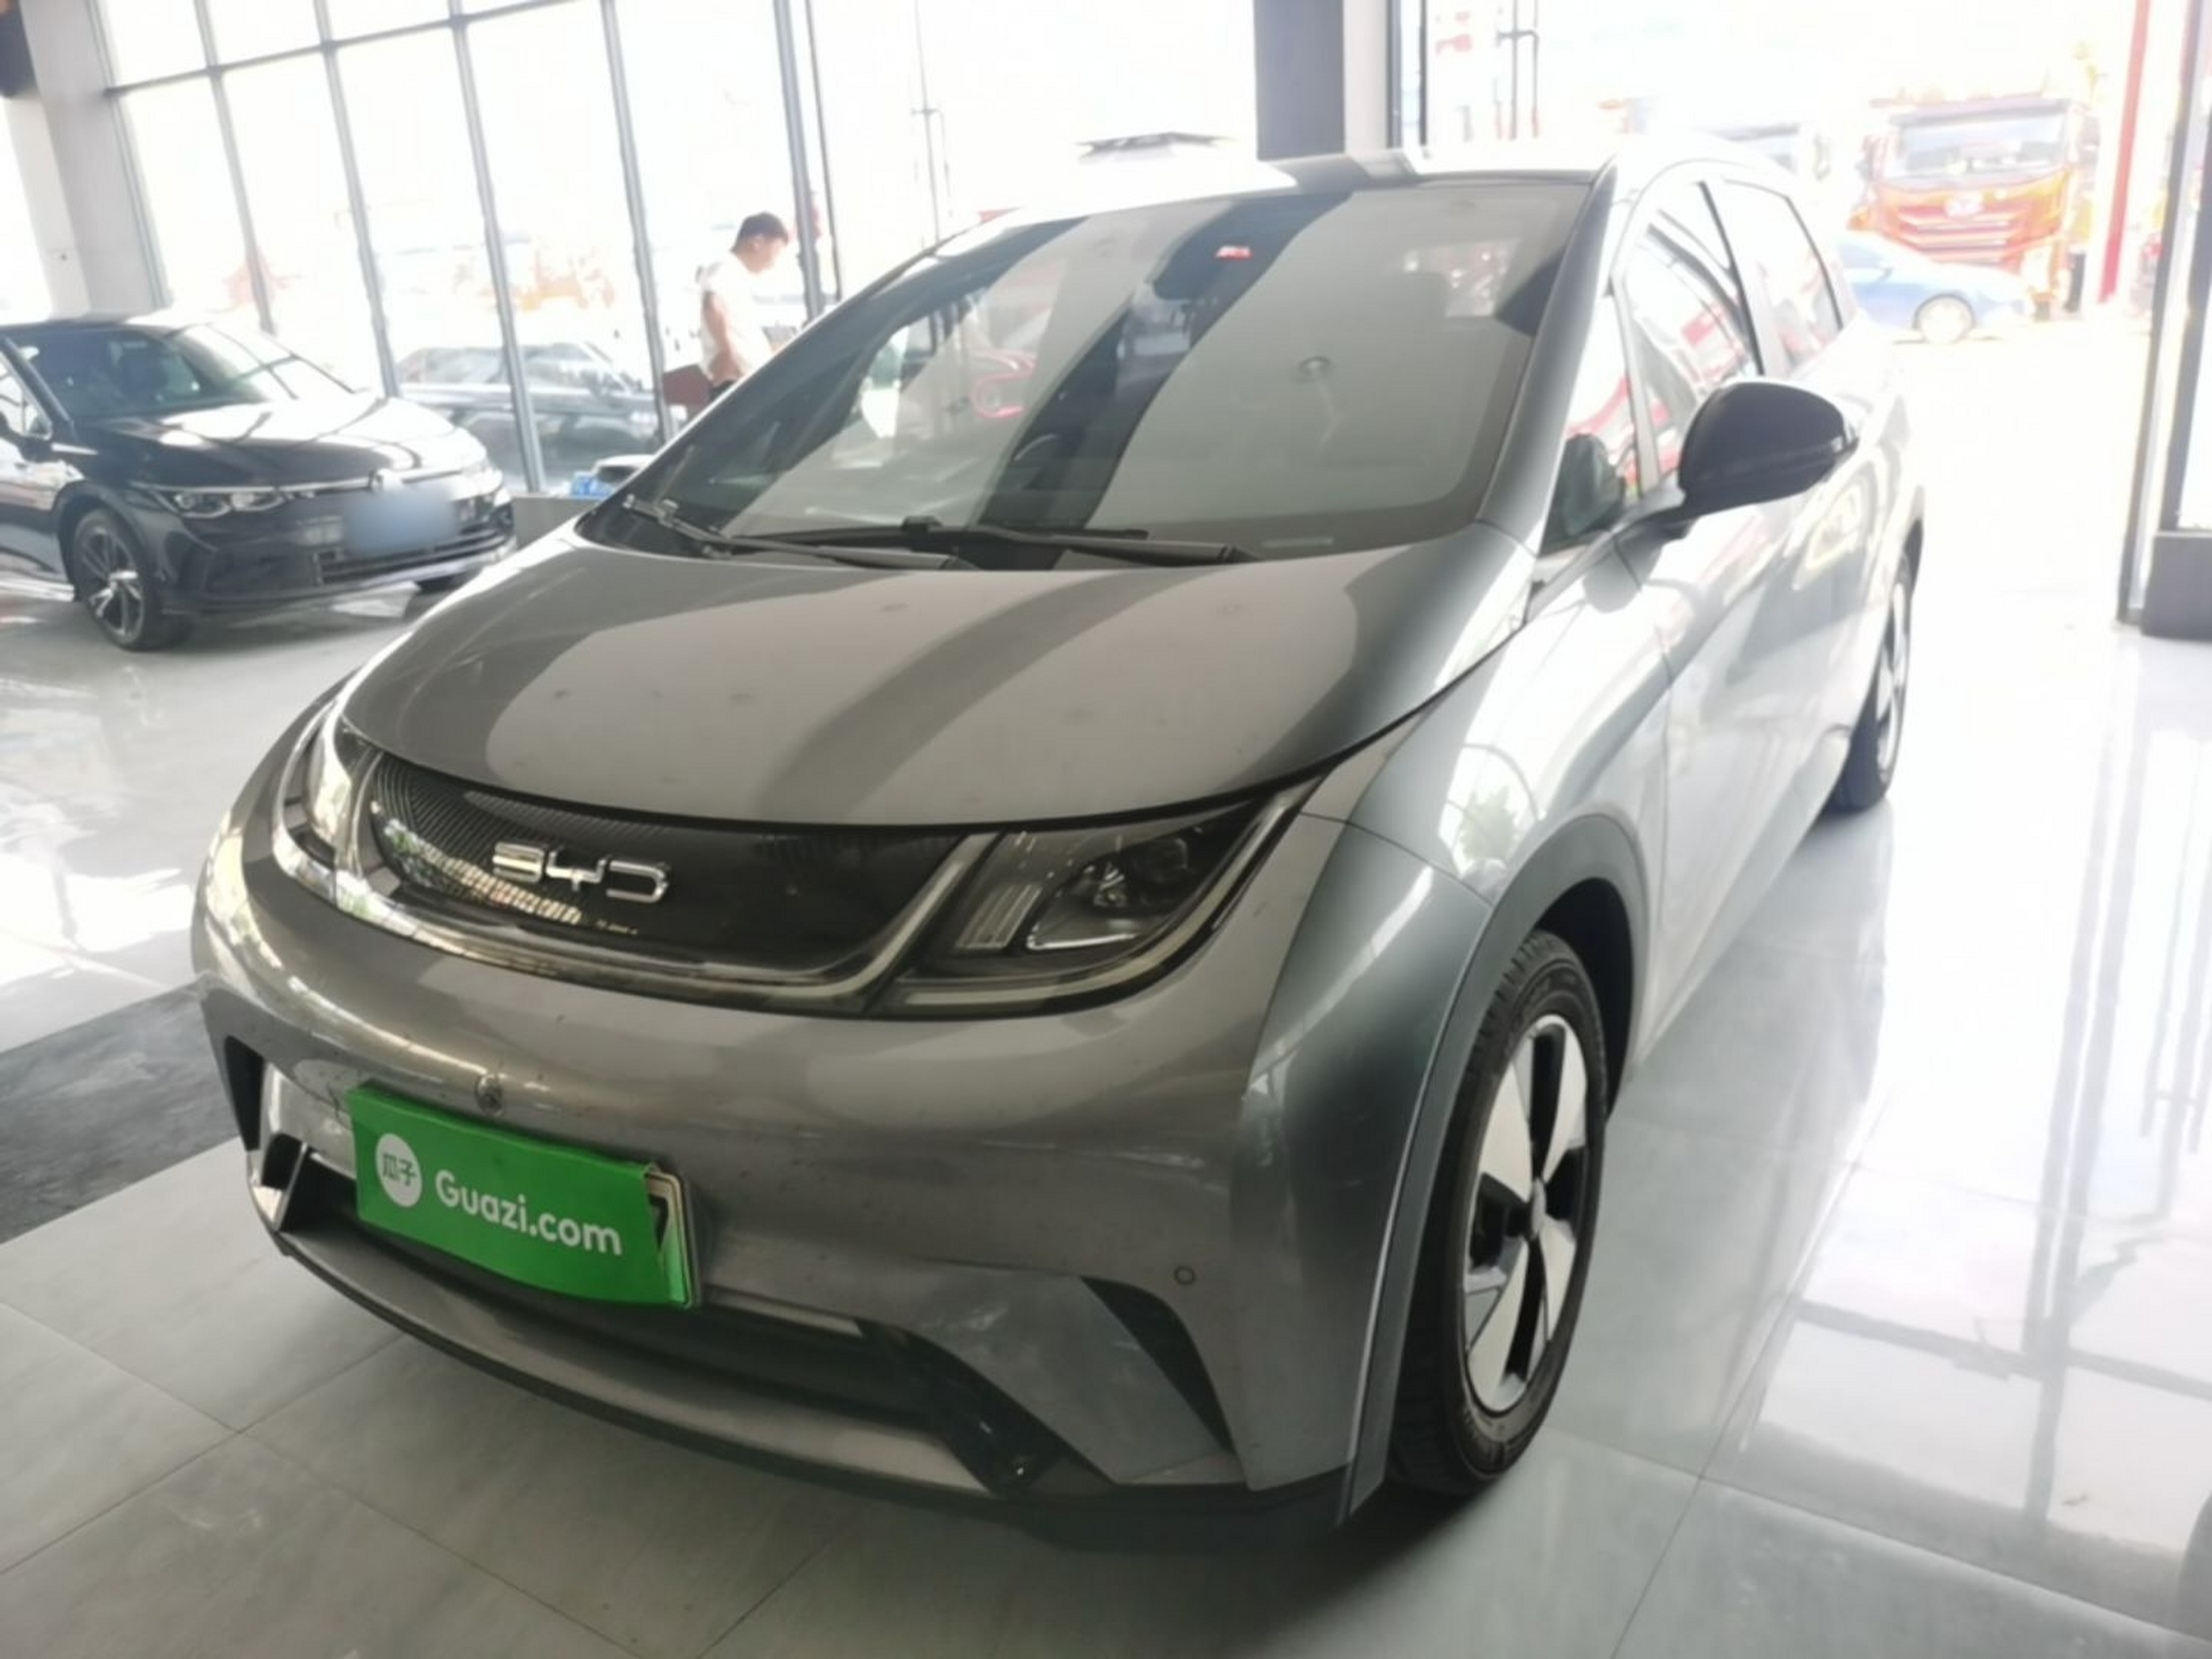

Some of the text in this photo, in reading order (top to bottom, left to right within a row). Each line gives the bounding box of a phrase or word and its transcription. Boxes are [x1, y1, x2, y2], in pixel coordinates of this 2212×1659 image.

[493, 842, 668, 903] BYD
[382, 1153, 418, 1187] 瓜子
[435, 1170, 622, 1256] Guazi.com
